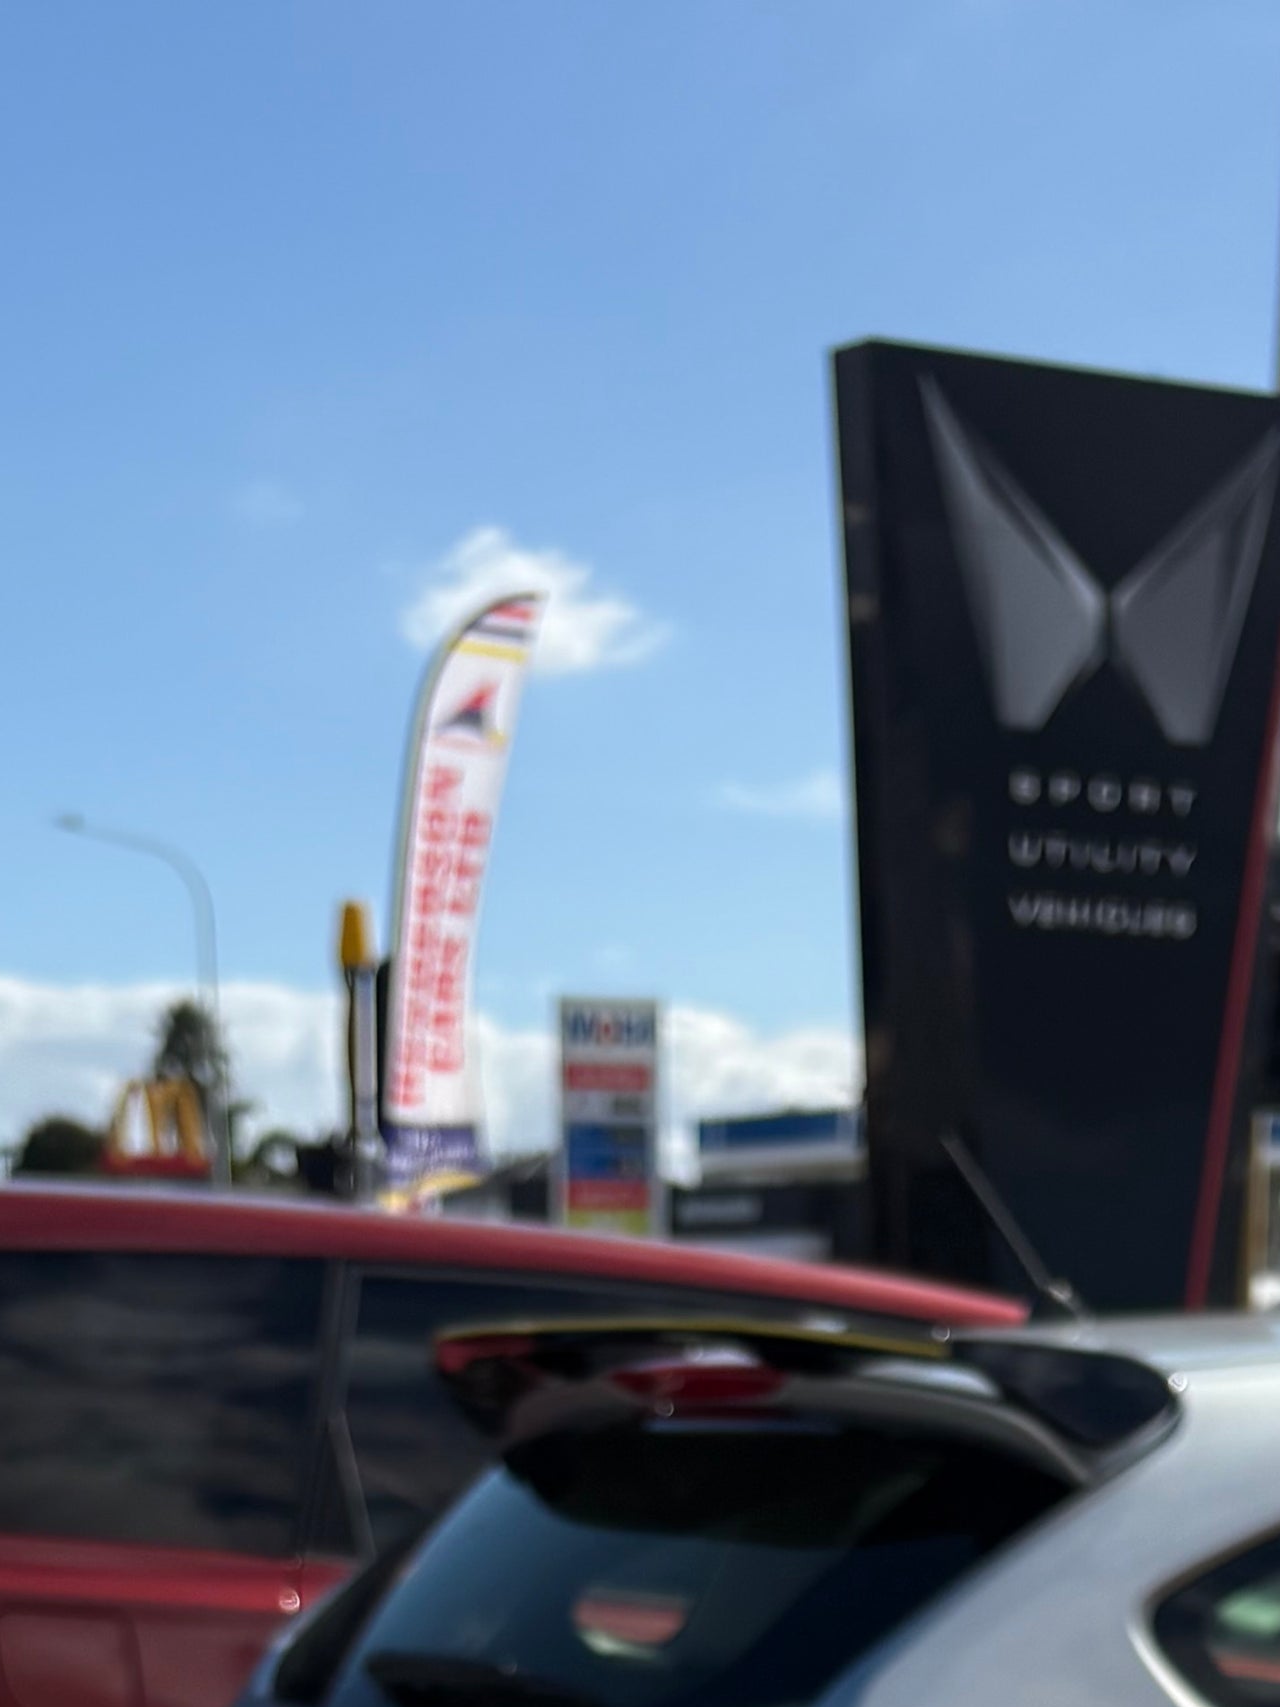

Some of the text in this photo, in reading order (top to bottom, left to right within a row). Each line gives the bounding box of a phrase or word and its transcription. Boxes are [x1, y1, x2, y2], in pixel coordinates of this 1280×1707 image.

[1008, 768, 1197, 818] SPORT
[1008, 831, 1198, 879] UTILITY
[1008, 892, 1198, 940] VEHICLES
